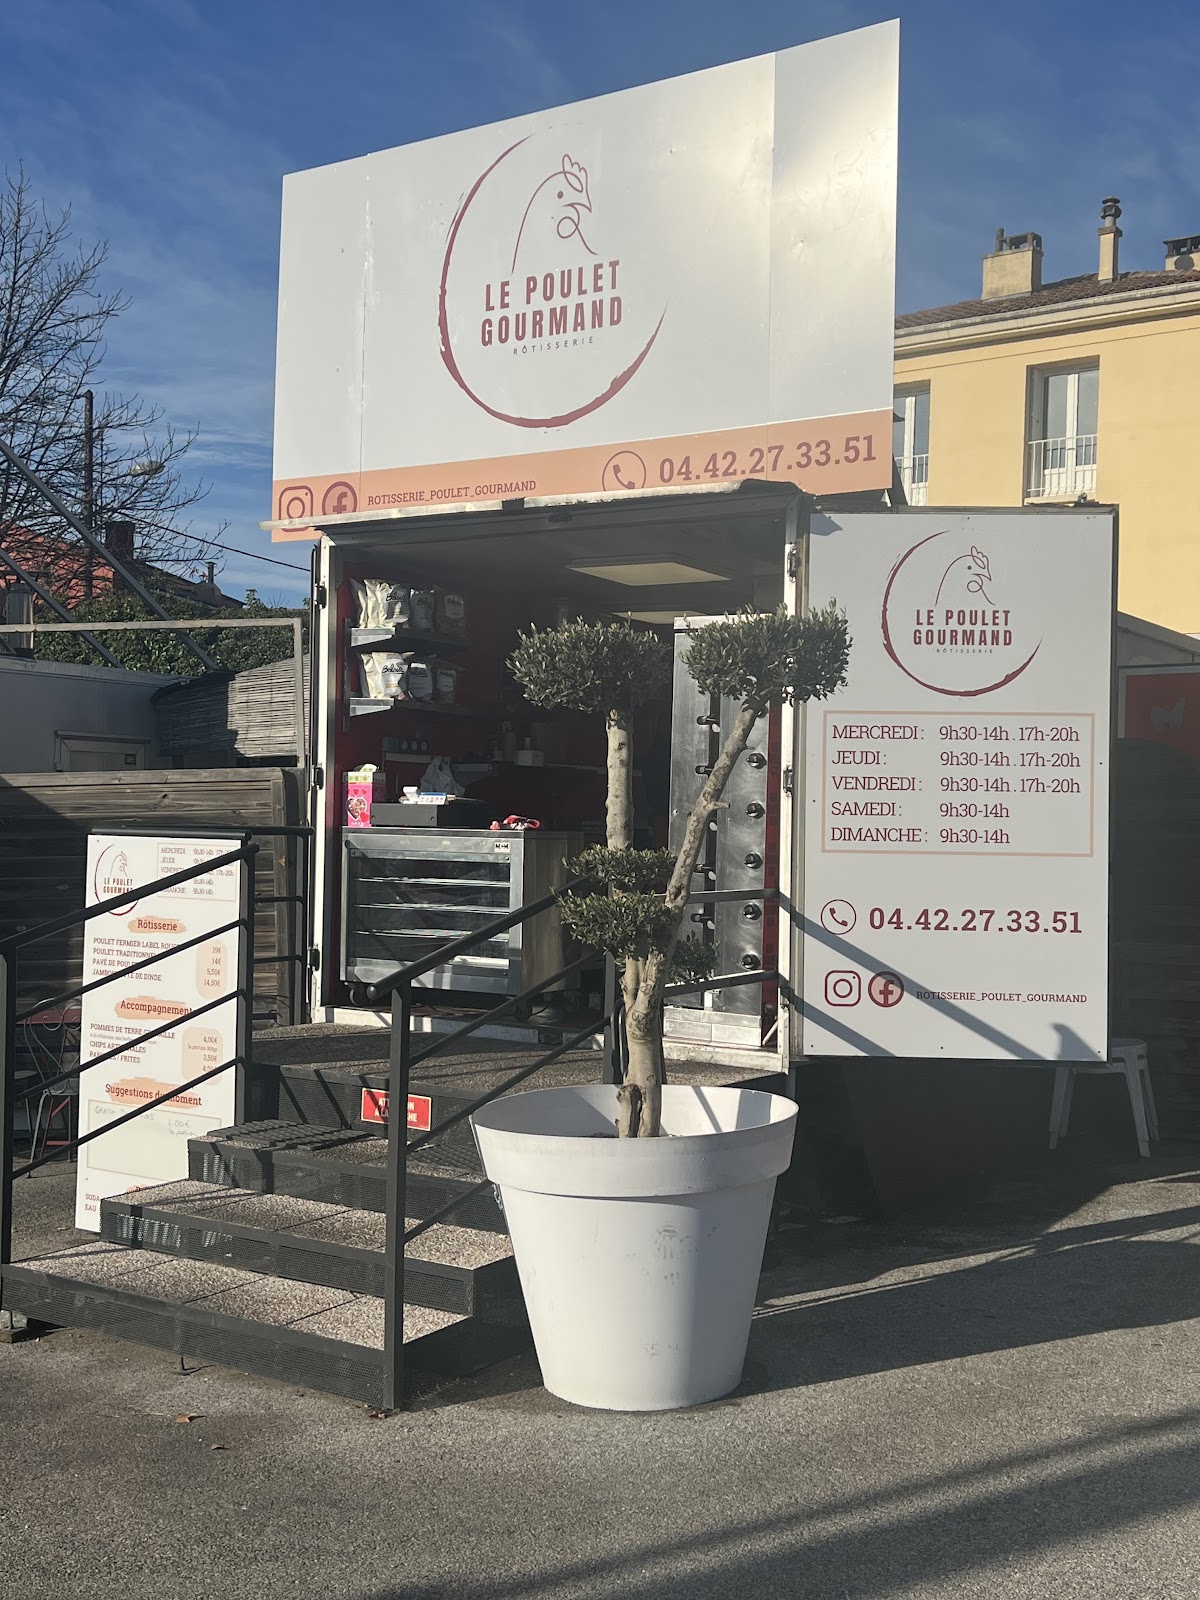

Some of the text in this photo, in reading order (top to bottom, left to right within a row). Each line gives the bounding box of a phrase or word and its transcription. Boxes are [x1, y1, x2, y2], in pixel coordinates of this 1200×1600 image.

[485, 259, 620, 312] LE POULET
[481, 296, 622, 347] GOURMAND
[513, 336, 594, 355] RÔTISSERIE
[659, 435, 877, 483] 04.42.27.33.51
[367, 480, 537, 506] ROTISSERIE_POULET_GOURMAND
[916, 609, 1010, 626] LE POULET
[913, 629, 1013, 646] GOURMAND
[939, 803, 1010, 818] 9h30-14h
[939, 828, 1010, 844] 9h30-14h
[113, 878, 133, 887] POULET
[137, 918, 178, 931] Rôtisserie
[868, 907, 1083, 934] 04.42.27.33.51
[93, 937, 115, 945] POULET
[115, 938, 142, 947] FERMIER
[142, 941, 160, 949] LABEL
[93, 947, 115, 956] POULET
[92, 957, 108, 966] PAVÉ
[143, 974, 162, 982] DINDE
[916, 990, 1088, 1003] ROTISSERIE_POULET_GOURMAND
[90, 1023, 114, 1032] POMMES
[115, 1025, 122, 1033] DE
[124, 1027, 142, 1035] TERRE
[90, 1041, 106, 1049] CHIPS
[105, 1083, 154, 1099] Suggestions
[84, 1203, 97, 1211] EAU
